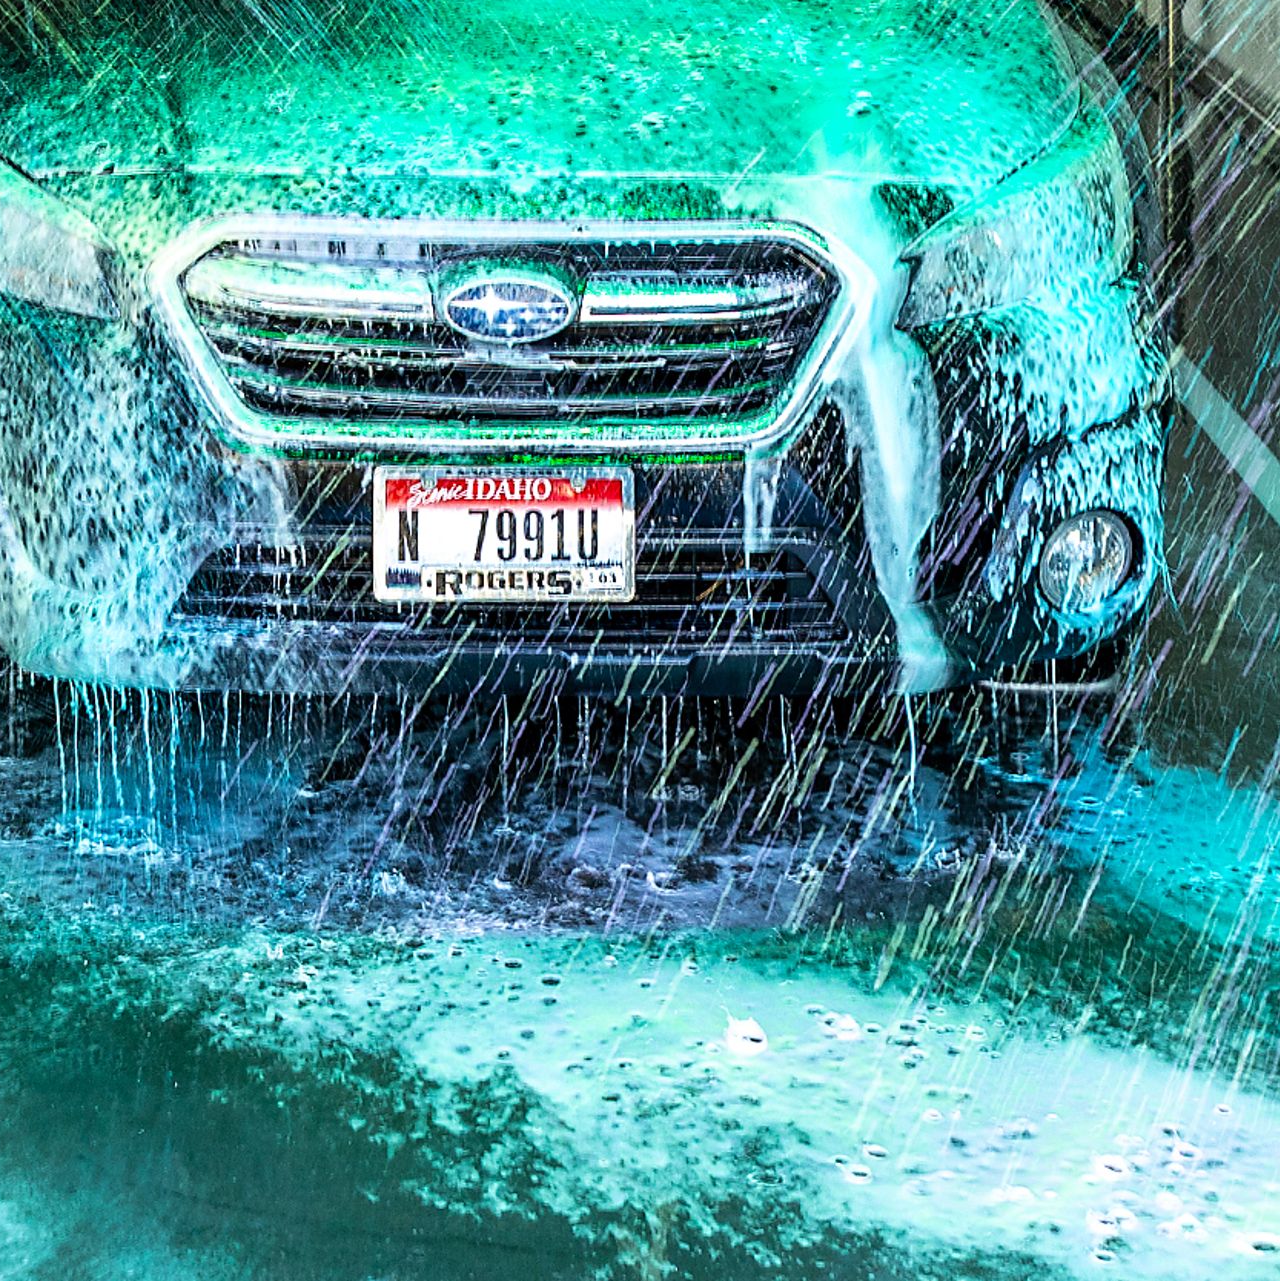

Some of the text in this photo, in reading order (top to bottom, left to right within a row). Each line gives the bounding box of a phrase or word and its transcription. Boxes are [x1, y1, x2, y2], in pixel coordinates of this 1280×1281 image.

[464, 478, 553, 501] IDAHO
[398, 508, 598, 561] N 7991U
[436, 570, 572, 596] ROGERS
